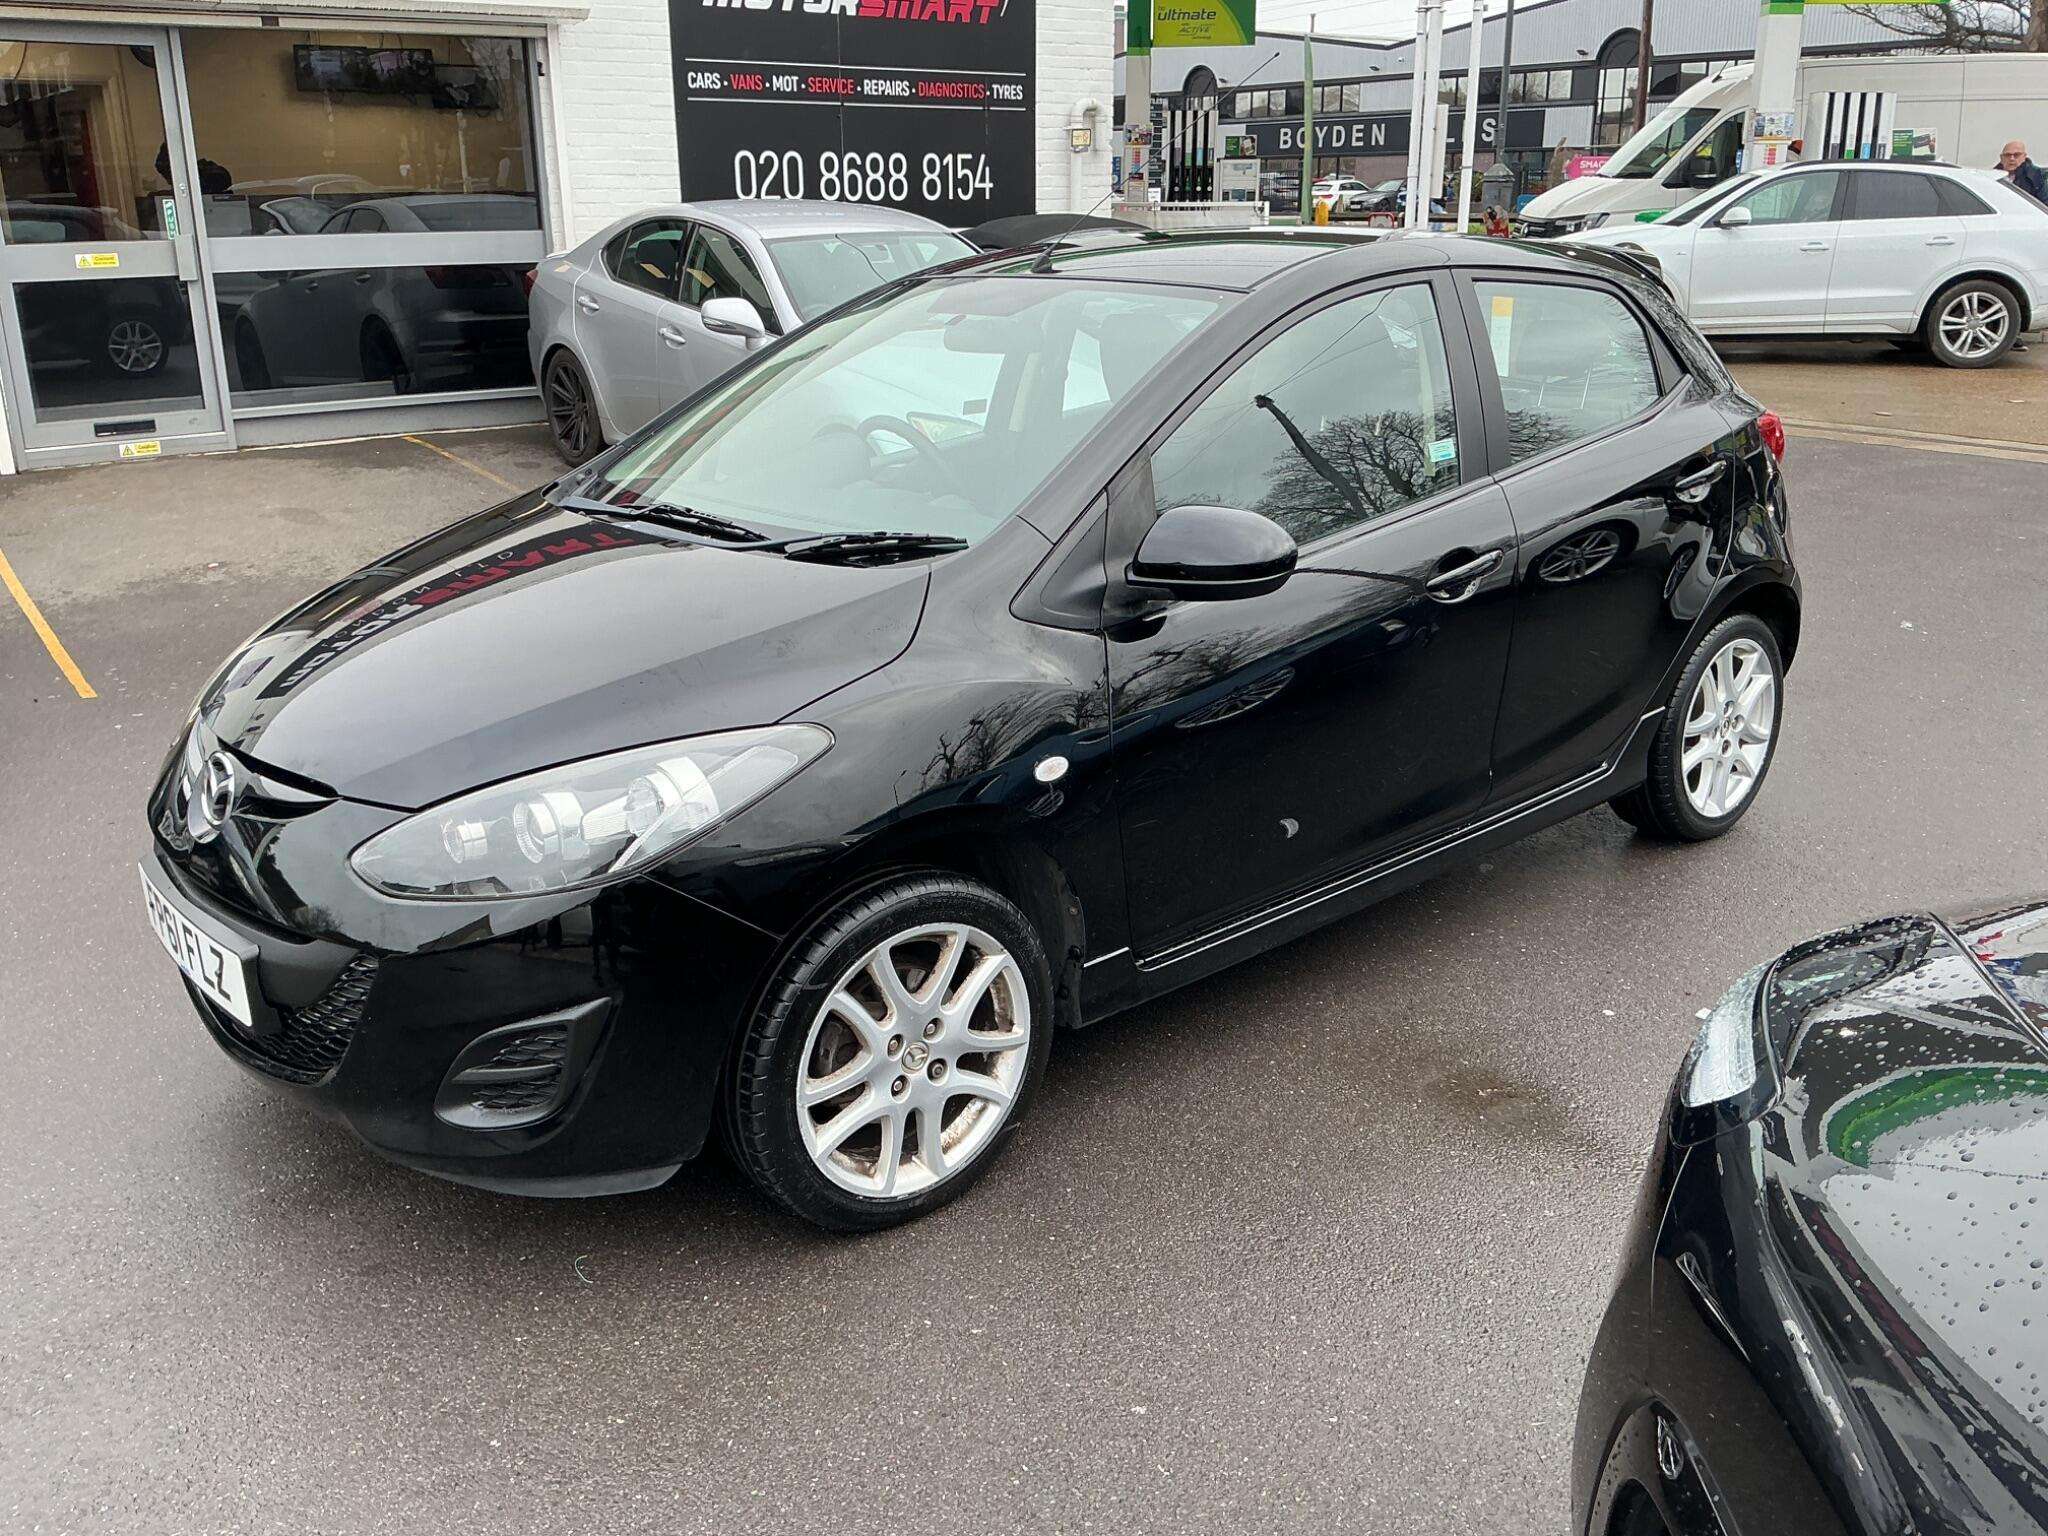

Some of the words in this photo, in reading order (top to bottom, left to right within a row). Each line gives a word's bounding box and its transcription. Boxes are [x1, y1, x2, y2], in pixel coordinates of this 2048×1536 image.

[703, 0, 999, 23] ORSMART
[687, 72, 721, 89] CARS
[730, 74, 763, 91] VANS
[772, 75, 799, 92] MOT
[808, 77, 855, 94] SERVICE
[863, 79, 910, 96] REPAIRS
[918, 82, 985, 99] DIAGNOSTICS
[992, 84, 1023, 100] TYRES
[1279, 123, 1386, 149] BOYDEN
[734, 150, 805, 200] 020
[819, 152, 909, 201] 8688
[922, 153, 994, 201] 8154
[181, 921, 232, 1002] FLZ
